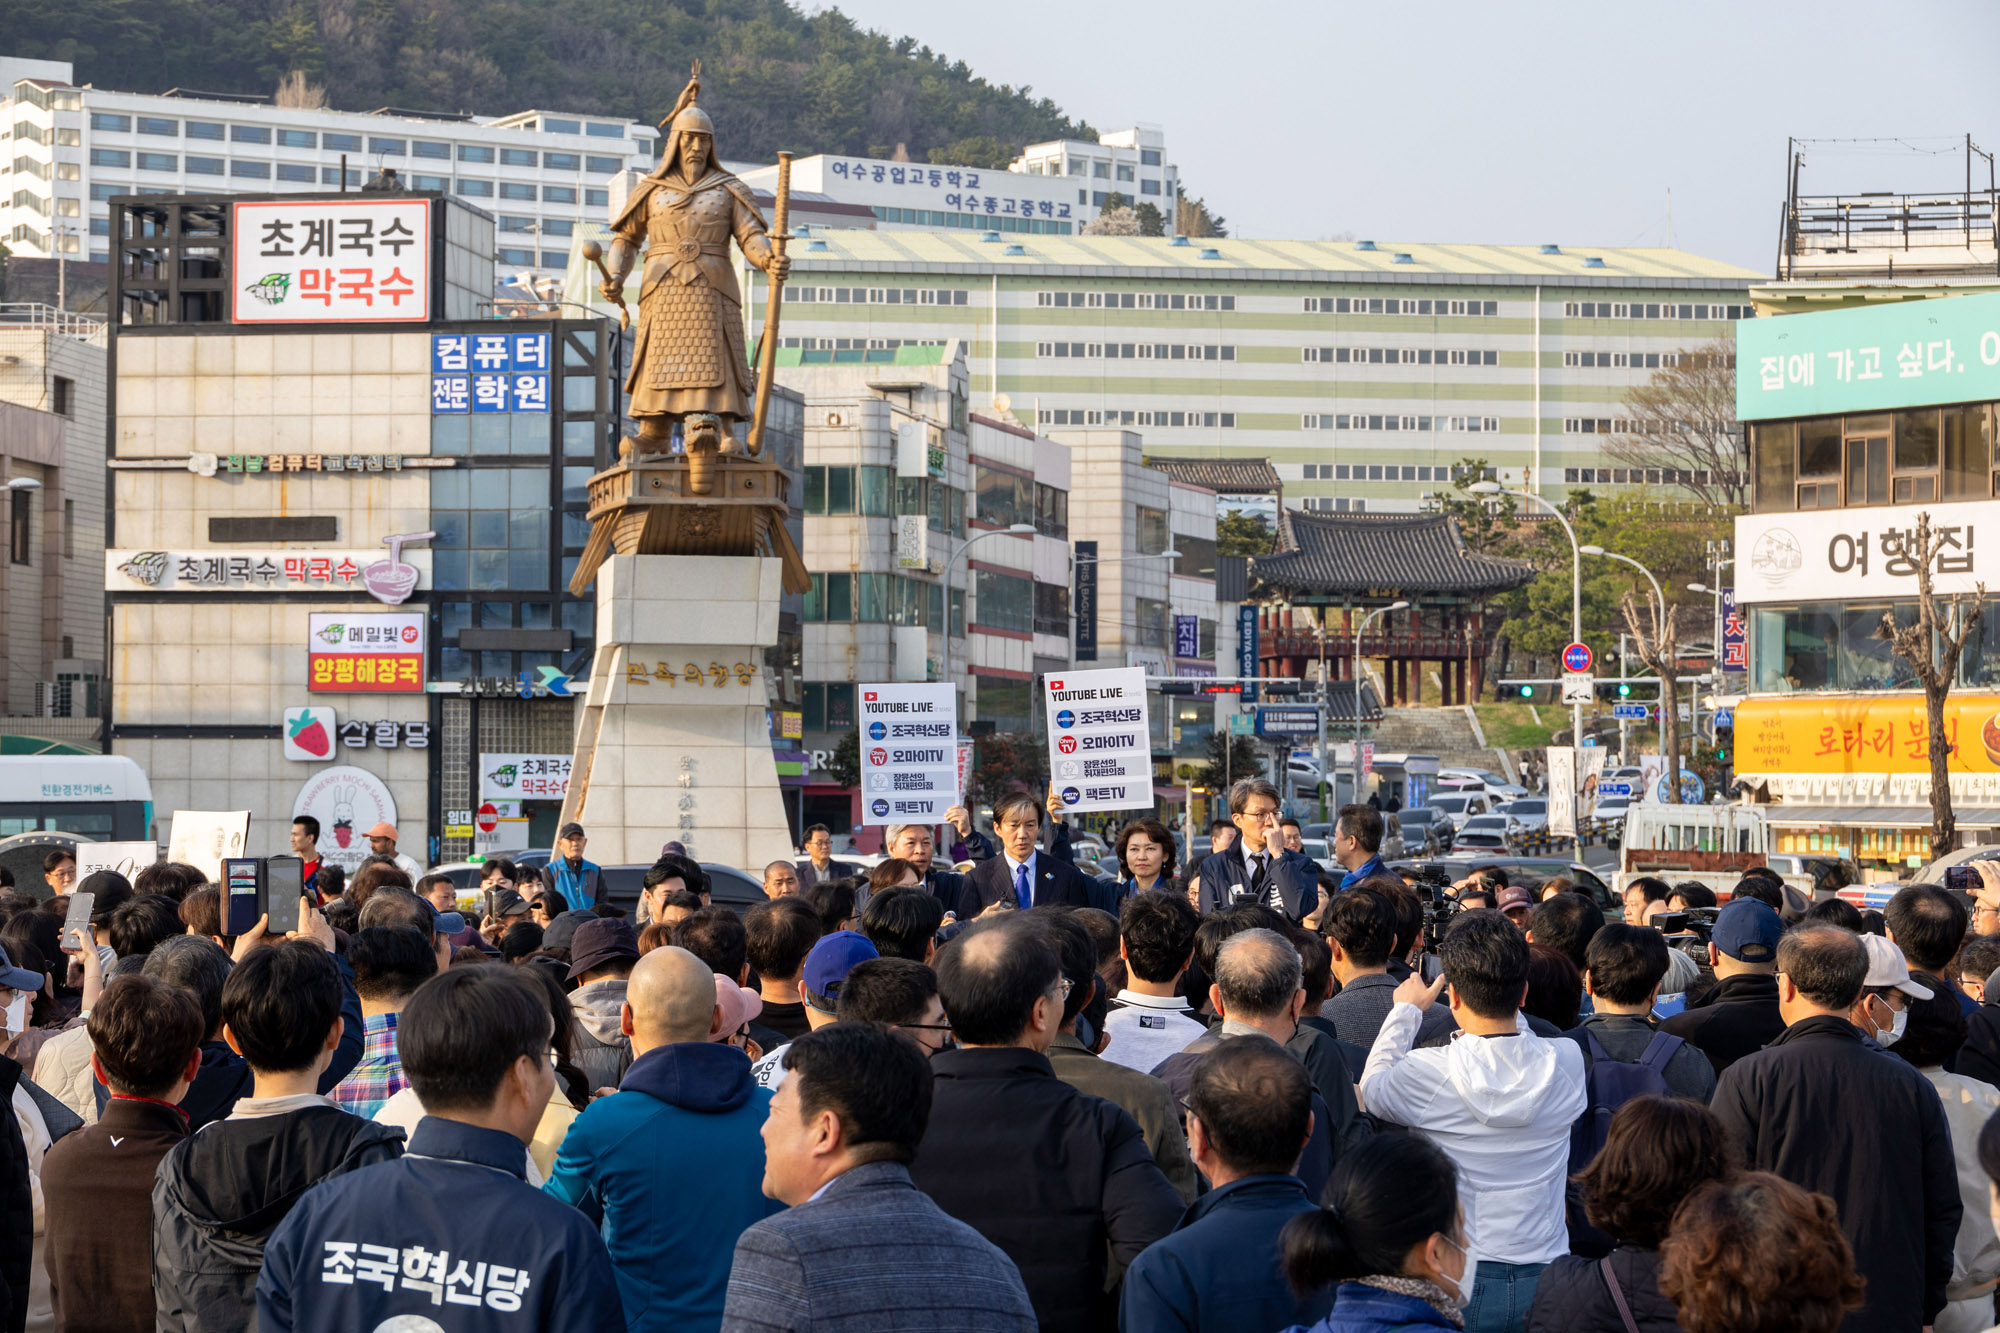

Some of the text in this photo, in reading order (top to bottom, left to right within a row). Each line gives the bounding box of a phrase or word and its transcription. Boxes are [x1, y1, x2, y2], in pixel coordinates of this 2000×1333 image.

[832, 161, 981, 190] 여수공업고등학교
[260, 217, 415, 258] 초계국수
[299, 267, 415, 307] 막국수
[436, 334, 548, 373] 컴퓨터
[1759, 352, 1815, 391] 집에
[1827, 347, 1883, 383] 가고
[1896, 338, 1965, 378] 싶다.
[433, 375, 547, 410] 전문 학원
[227, 453, 402, 473] 전남 컴퓨터 교육센터
[1828, 525, 1974, 578] 여행집
[177, 557, 277, 582] 초계국수
[284, 557, 359, 582] 막국수
[1081, 588, 1090, 640] BAGUETTE
[348, 626, 399, 643] 메밀빛
[403, 629, 418, 641] 2F
[1178, 623, 1195, 656] 치과
[1244, 621, 1252, 652] EDIYA
[313, 657, 419, 684] 양평해장국
[1052, 688, 1097, 702] YOUTUBE
[1100, 687, 1123, 699] LIVE
[865, 702, 909, 714] YOUTUBE
[911, 702, 934, 713] LIVE
[1081, 708, 1141, 725] 조국혁신당
[891, 724, 951, 737] 조국혁신당
[1062, 744, 1074, 753] TV
[1082, 734, 1135, 750] 오마이TV
[1814, 721, 1894, 759] 로타리
[872, 756, 885, 765] TV
[892, 749, 944, 763] 오마이TV
[1083, 759, 1117, 769] 장윤선의
[521, 759, 572, 775] 초계국수
[1084, 767, 1126, 777] 취재편의점
[893, 773, 926, 782] 장윤선의
[894, 781, 934, 790] 취재편의점
[41, 783, 113, 796] 친환경전기버스
[521, 778, 561, 795] 막국수
[1086, 786, 1126, 800] 팩트TV
[302, 774, 386, 822] STRAWBERRY MOCHI SAMHA
[895, 801, 934, 813] 팩트TV
[447, 810, 472, 825] 임대
[758, 1054, 780, 1088] idas
[321, 1240, 531, 1312] 조국혁신당
